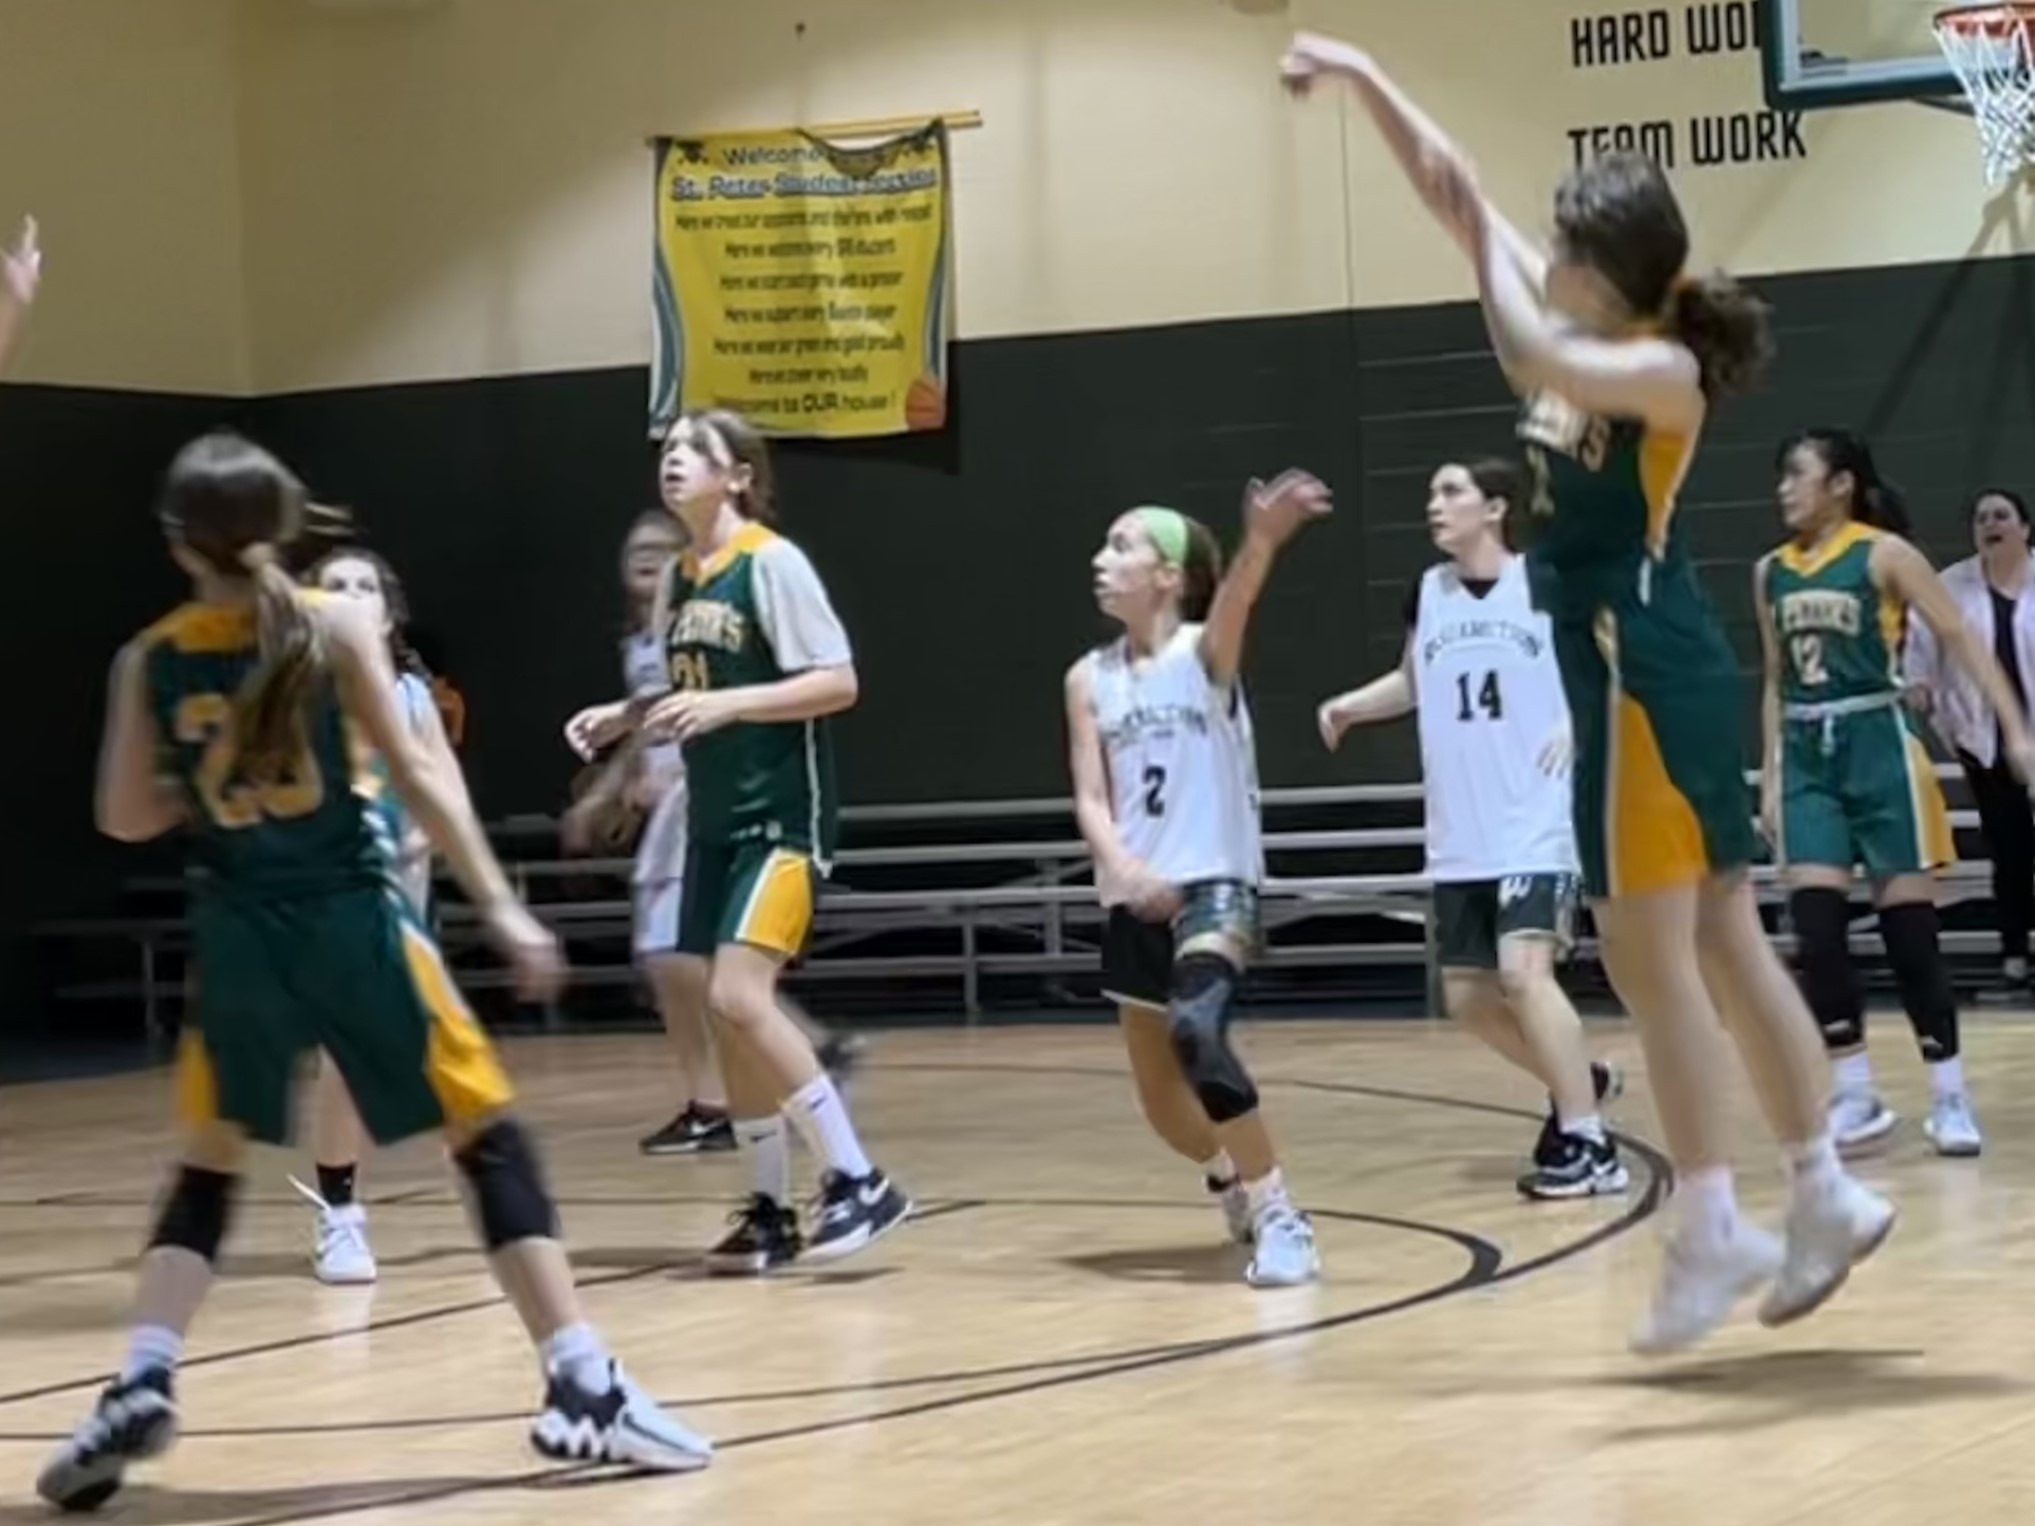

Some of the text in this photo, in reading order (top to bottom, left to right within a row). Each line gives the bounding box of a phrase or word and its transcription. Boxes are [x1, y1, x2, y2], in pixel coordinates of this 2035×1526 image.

[1571, 9, 1670, 67] HARD
[1689, 110, 1807, 165] WORK
[802, 389, 837, 413] OUR
[1455, 667, 1503, 722] 14
[1143, 765, 1166, 818] 2
